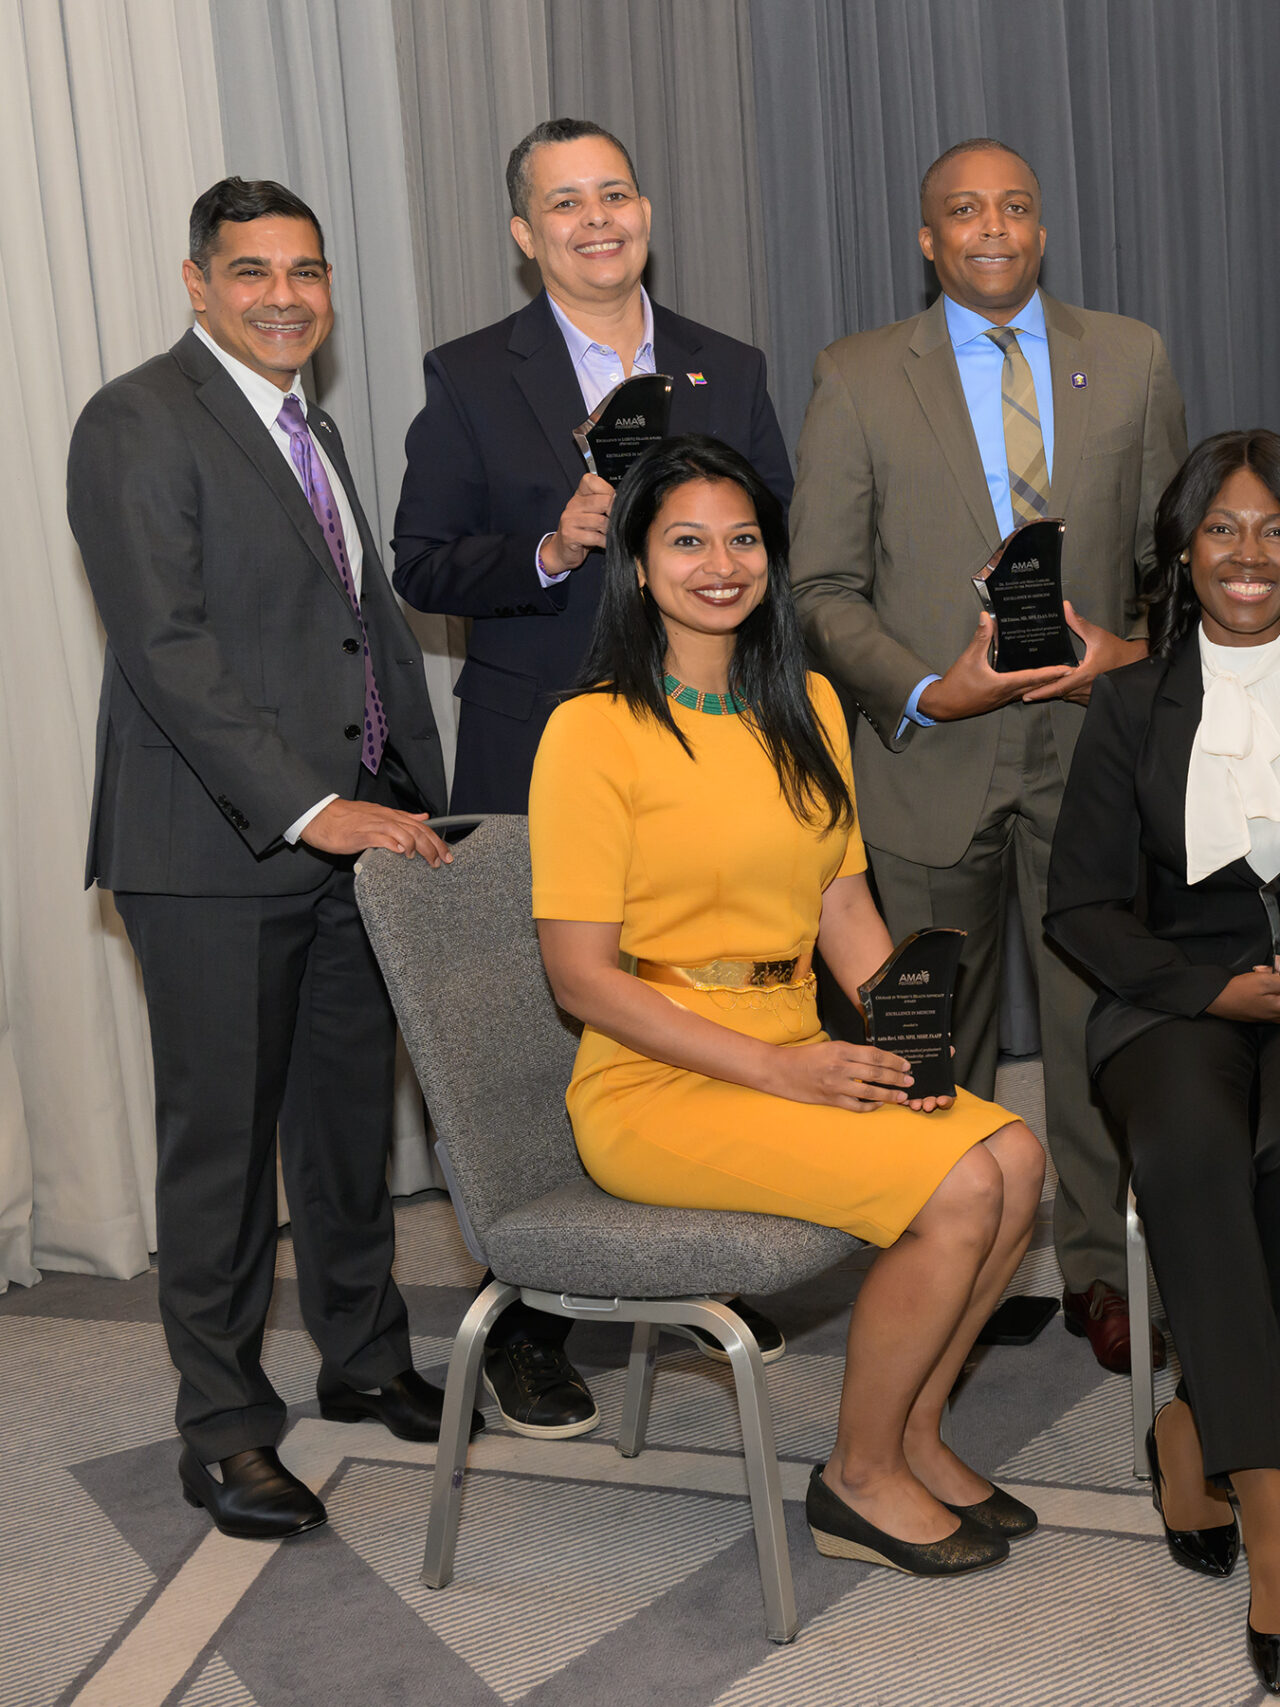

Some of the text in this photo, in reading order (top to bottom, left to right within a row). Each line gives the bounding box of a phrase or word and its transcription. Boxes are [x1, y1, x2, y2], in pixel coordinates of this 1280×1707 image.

[616, 418, 638, 426] AMA
[1011, 561, 1033, 570] AMA
[899, 973, 922, 982] AMA
